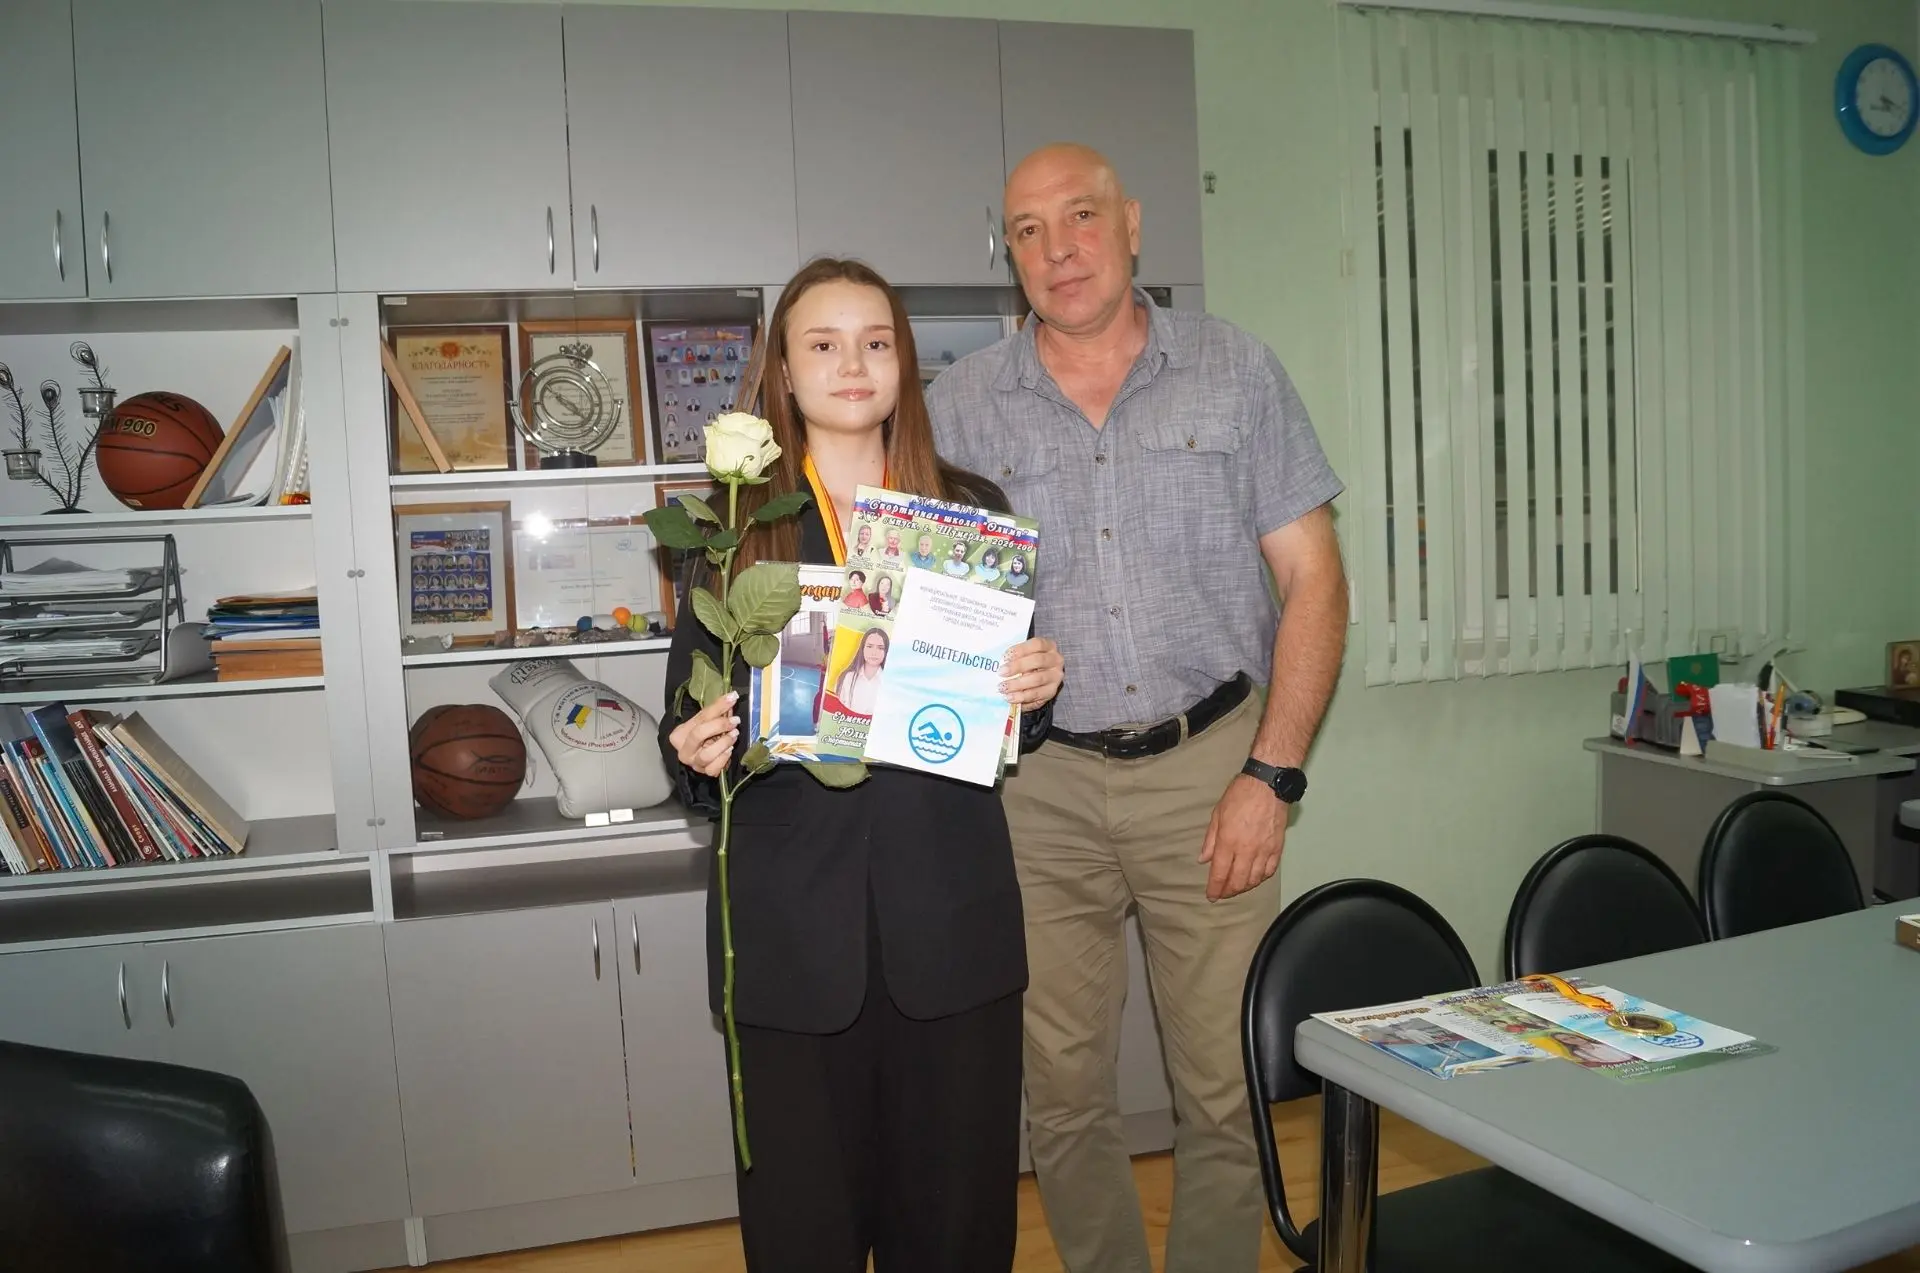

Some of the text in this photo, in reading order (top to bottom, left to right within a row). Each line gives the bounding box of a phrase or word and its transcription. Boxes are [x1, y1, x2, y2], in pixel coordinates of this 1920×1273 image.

[122, 418, 156, 436] 900
[943, 515, 977, 528] школа
[912, 639, 999, 673] СВИДЕТЕЛЬСТВО
